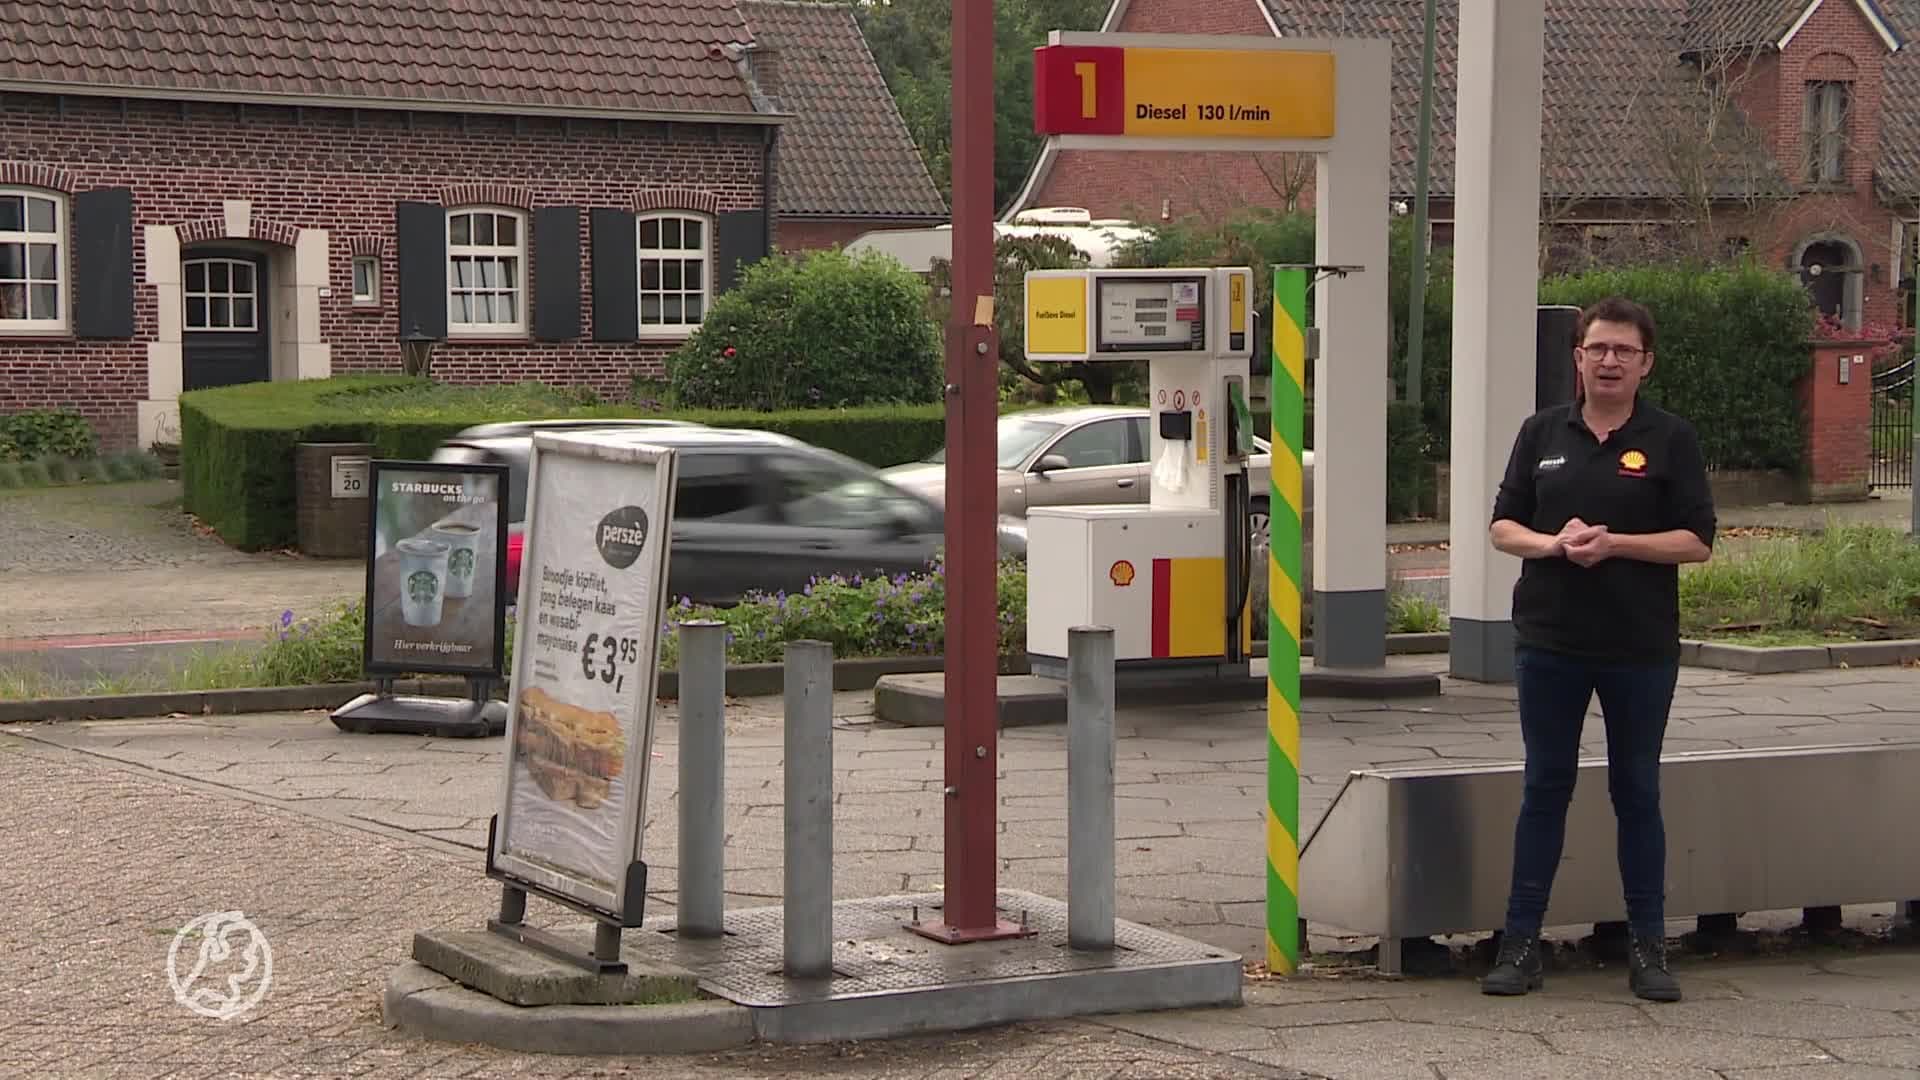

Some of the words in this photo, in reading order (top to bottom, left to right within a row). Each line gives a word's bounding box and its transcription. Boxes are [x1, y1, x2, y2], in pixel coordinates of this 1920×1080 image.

[1074, 61, 1097, 119] 1
[1136, 103, 1186, 120] Diesel
[1197, 104, 1225, 121] 130
[1229, 104, 1270, 121] l/min
[1060, 310, 1076, 319] Diesel
[343, 479, 361, 491] 20
[391, 482, 464, 495] STARBUCKS
[442, 494, 456, 503] on
[457, 493, 472, 504] the
[472, 496, 485, 505] go
[542, 565, 574, 590] Broodje
[539, 586, 556, 610] jong
[558, 589, 593, 618] belegen
[594, 595, 616, 616] kaas
[539, 611, 548, 625] en
[393, 639, 416, 649] Hier
[415, 640, 473, 654] verkrijgbaar
